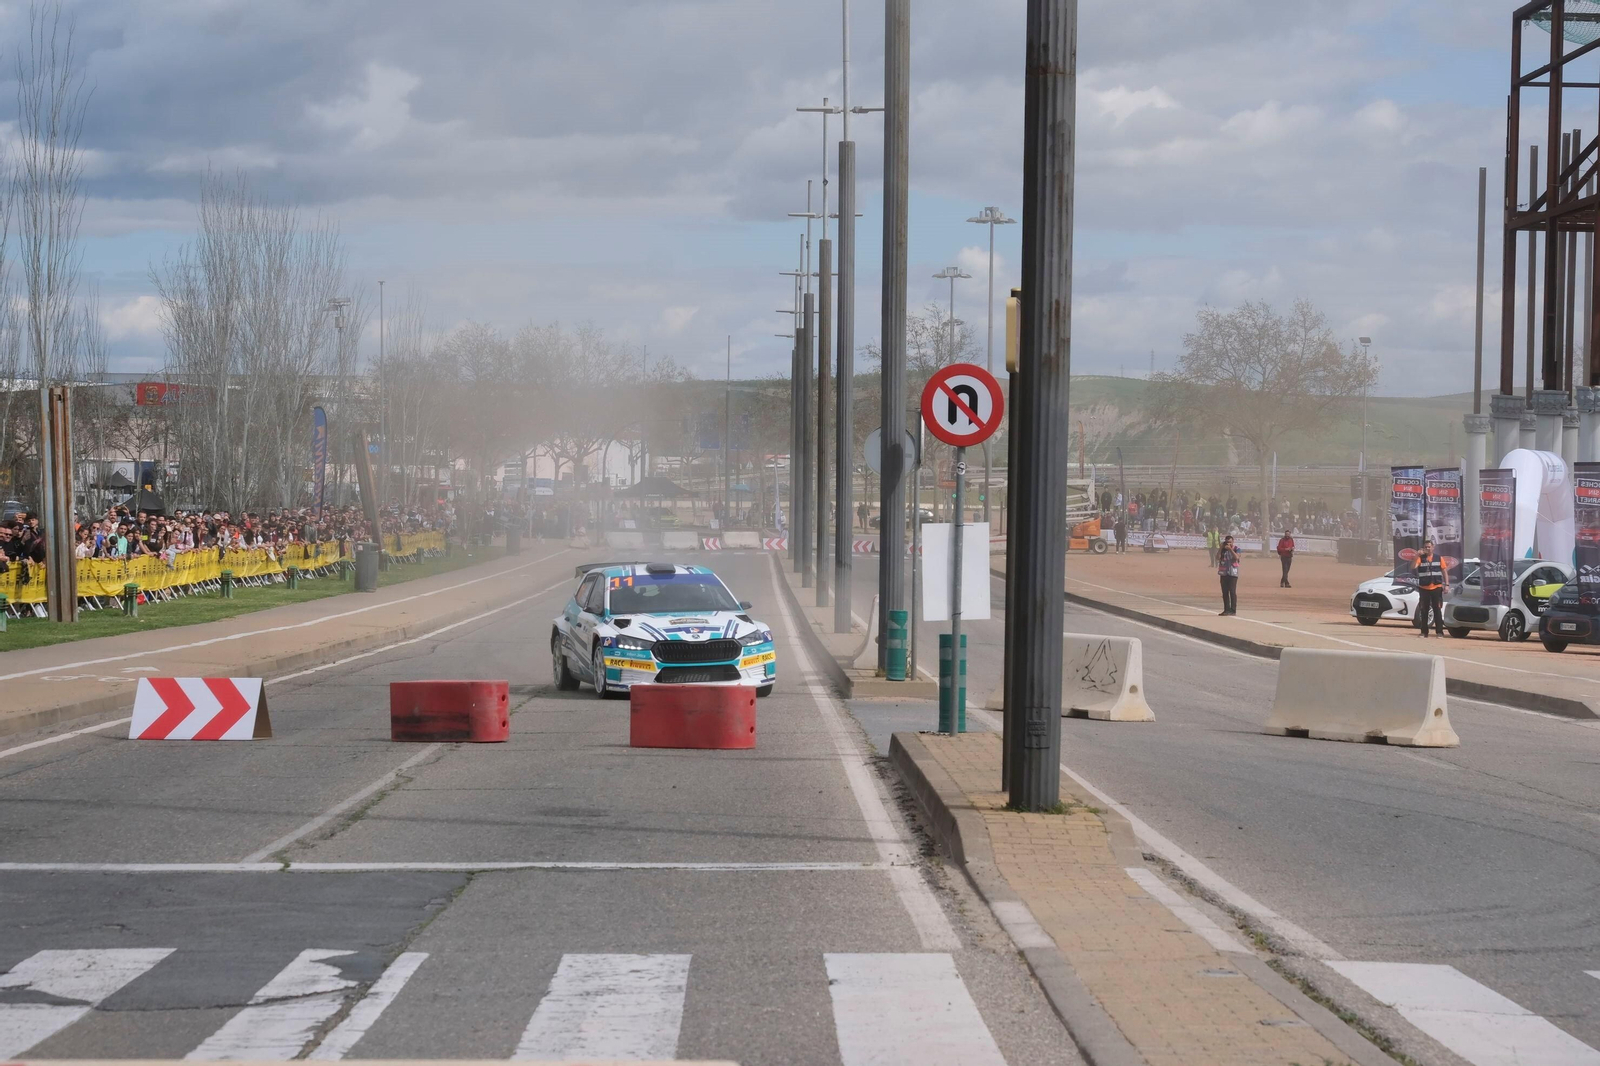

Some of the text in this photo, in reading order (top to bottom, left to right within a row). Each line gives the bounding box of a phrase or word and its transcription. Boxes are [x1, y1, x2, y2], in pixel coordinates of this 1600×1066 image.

[610, 576, 633, 587] 11
[762, 652, 774, 661] RACC
[609, 658, 651, 670] RACC PIRELLI
